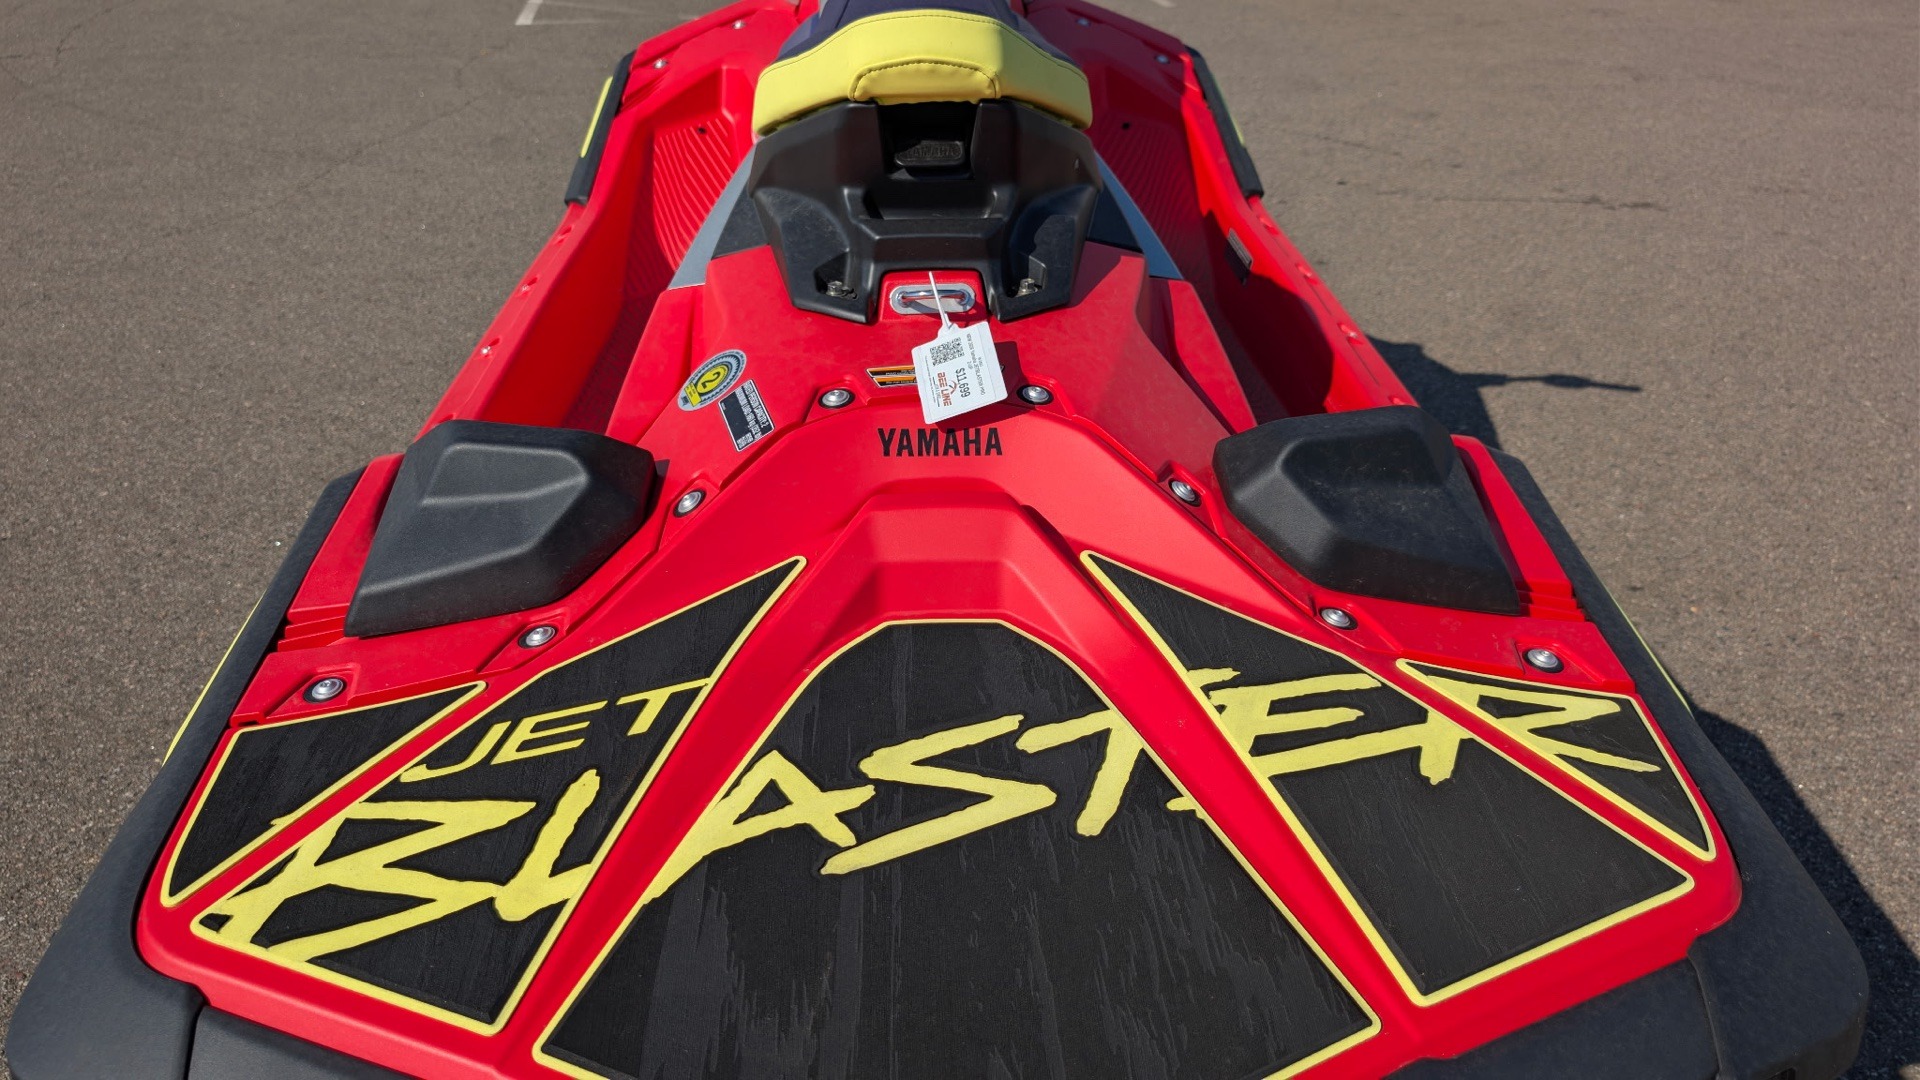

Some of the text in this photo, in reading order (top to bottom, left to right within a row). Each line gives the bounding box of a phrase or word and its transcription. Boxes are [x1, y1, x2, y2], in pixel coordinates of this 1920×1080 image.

[701, 371, 721, 389] 2
[937, 371, 948, 387] BEE
[940, 388, 952, 407] LINE
[878, 428, 1003, 457] YAMAHA
[400, 679, 708, 782] JET
